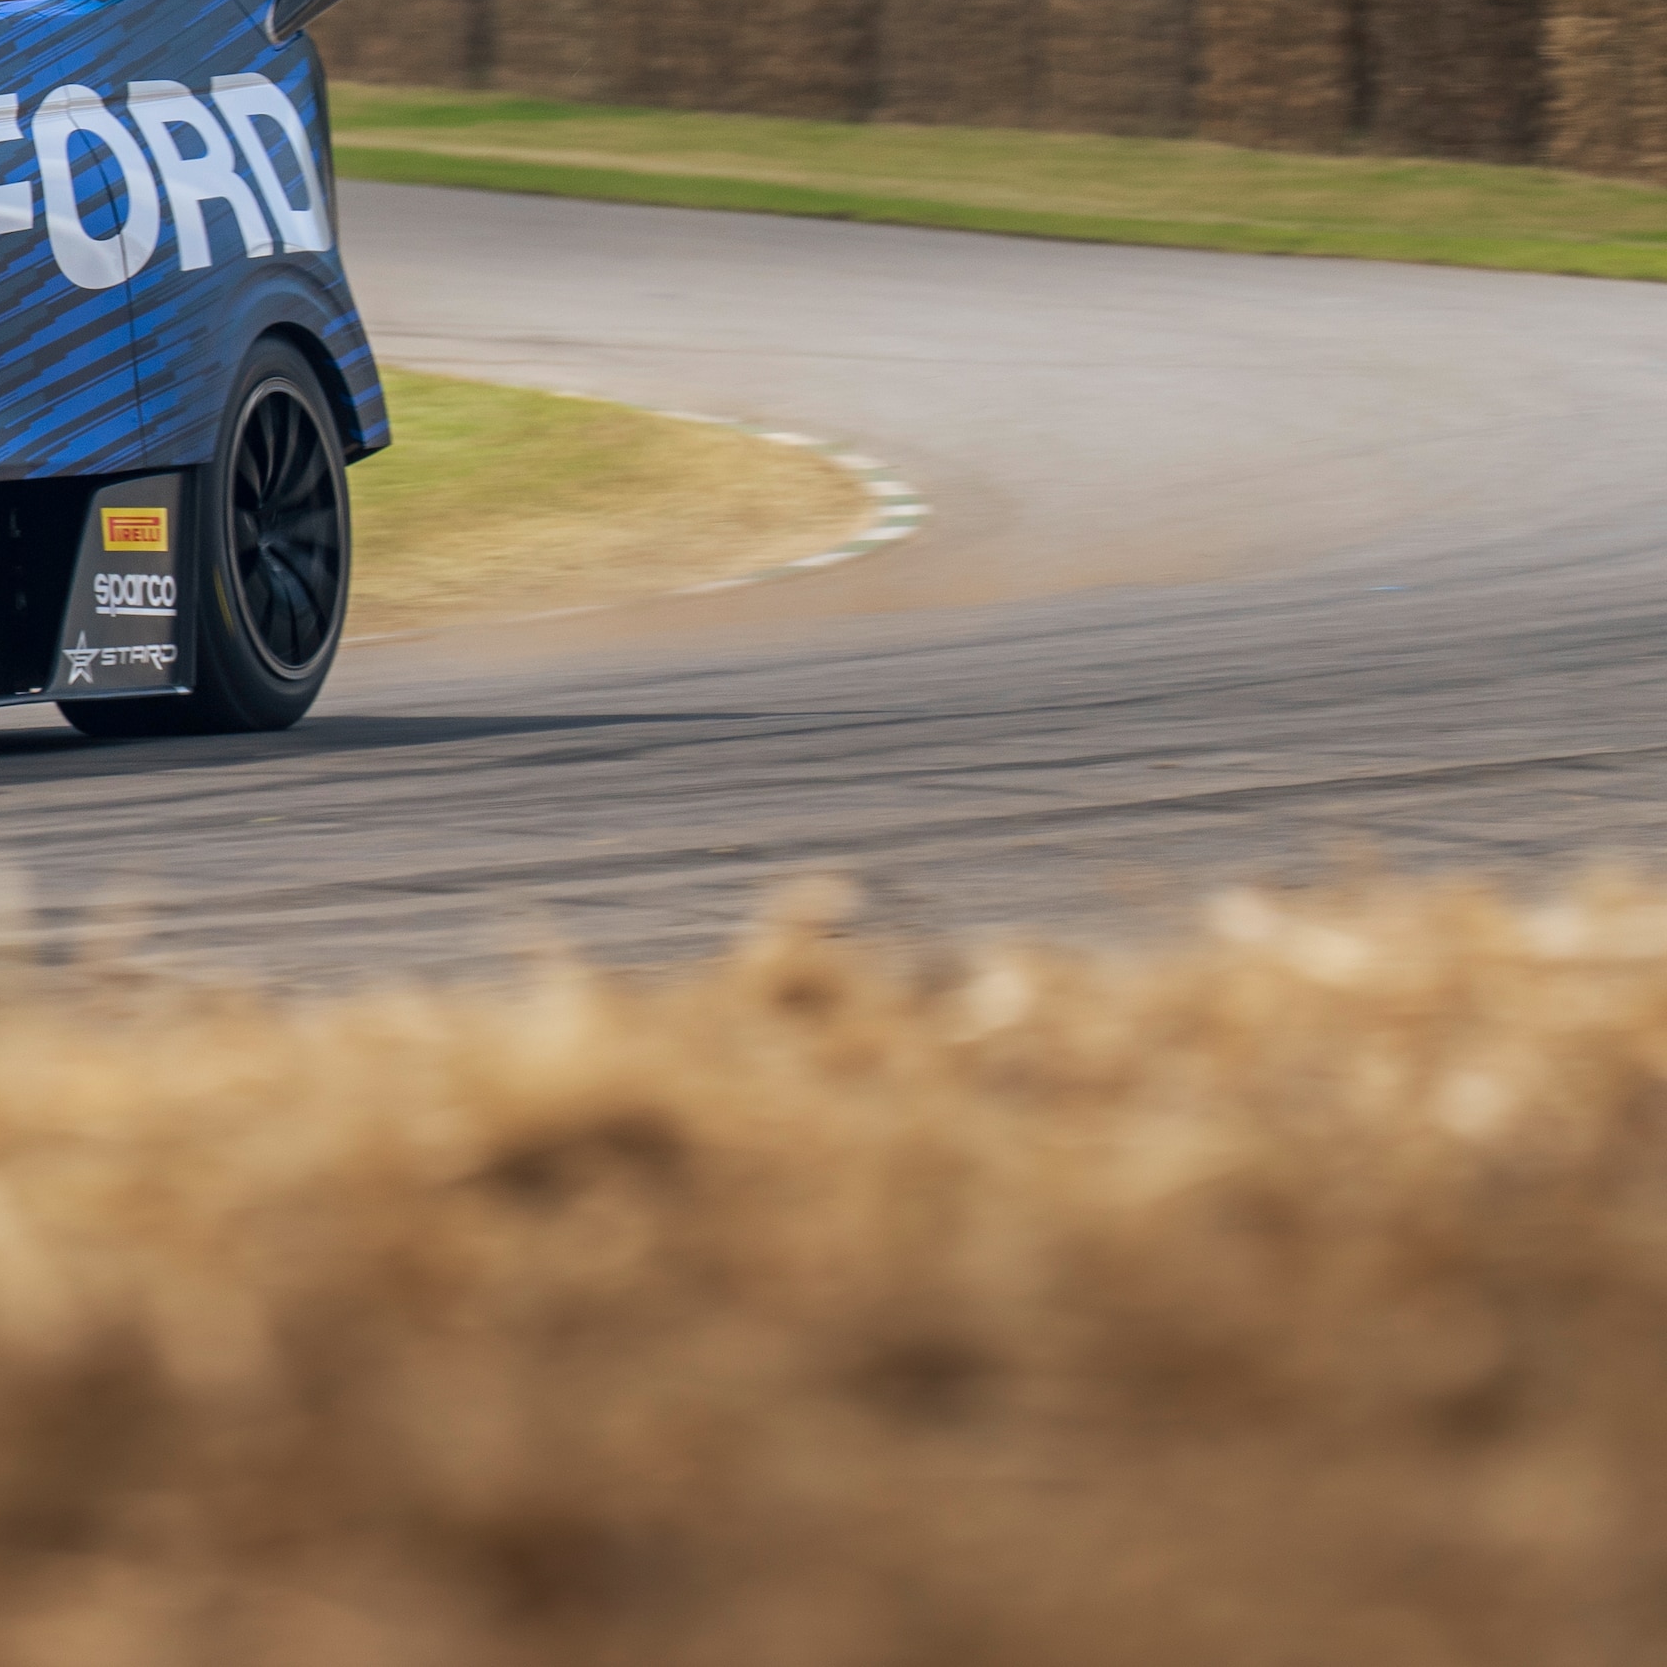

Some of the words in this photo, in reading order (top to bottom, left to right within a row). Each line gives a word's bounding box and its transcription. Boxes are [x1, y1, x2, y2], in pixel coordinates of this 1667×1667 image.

[108, 516, 161, 543] PIRELLI
[93, 573, 177, 617] sparco
[100, 643, 179, 671] STARD
